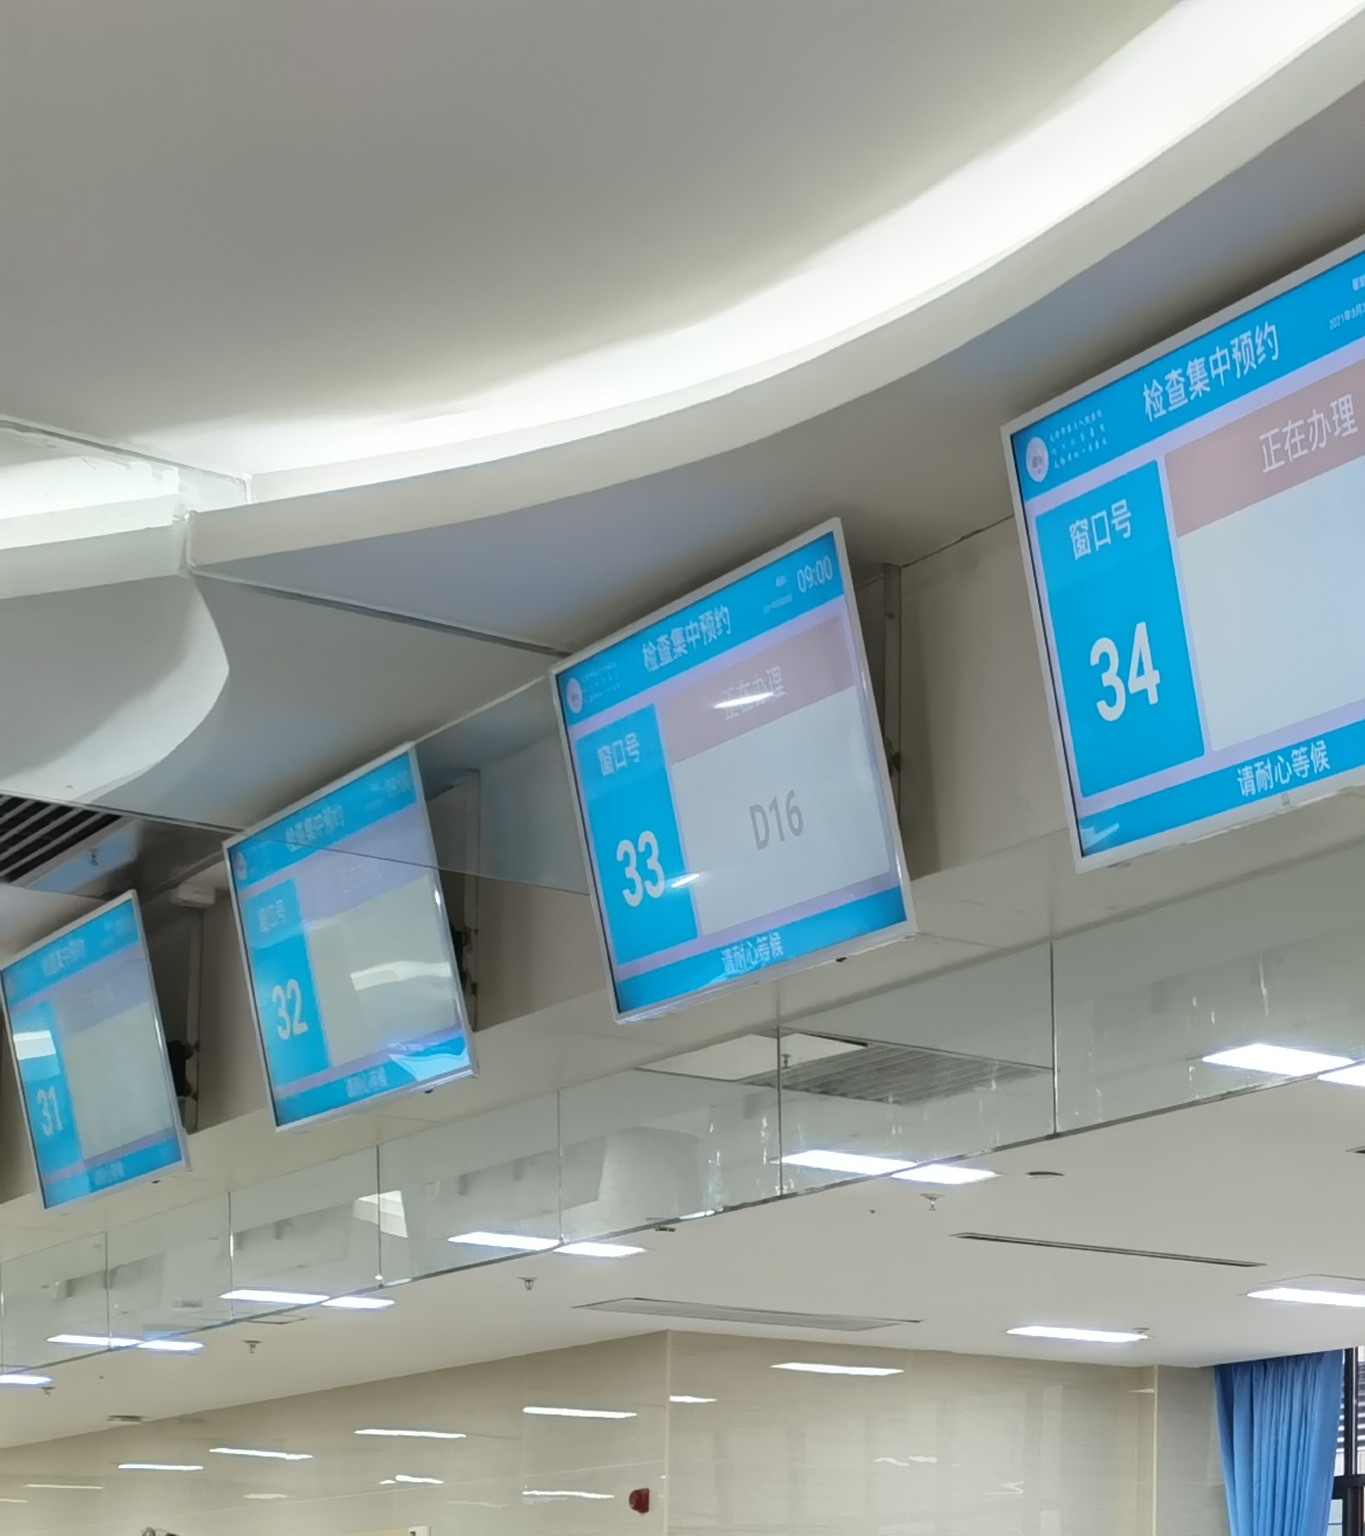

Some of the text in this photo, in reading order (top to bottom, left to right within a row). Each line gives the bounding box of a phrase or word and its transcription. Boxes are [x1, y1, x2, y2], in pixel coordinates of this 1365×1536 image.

[1143, 322, 1280, 422] 检查集中预约
[1260, 394, 1358, 475] 正在办理
[1069, 499, 1133, 561] 窗口号
[797, 556, 833, 593] 09:00
[1090, 621, 1161, 722] 34
[1236, 740, 1331, 799] 请耐心等候
[749, 790, 804, 851] D16
[616, 830, 665, 908] 33
[272, 980, 308, 1040] 32
[36, 1086, 64, 1137] 31
